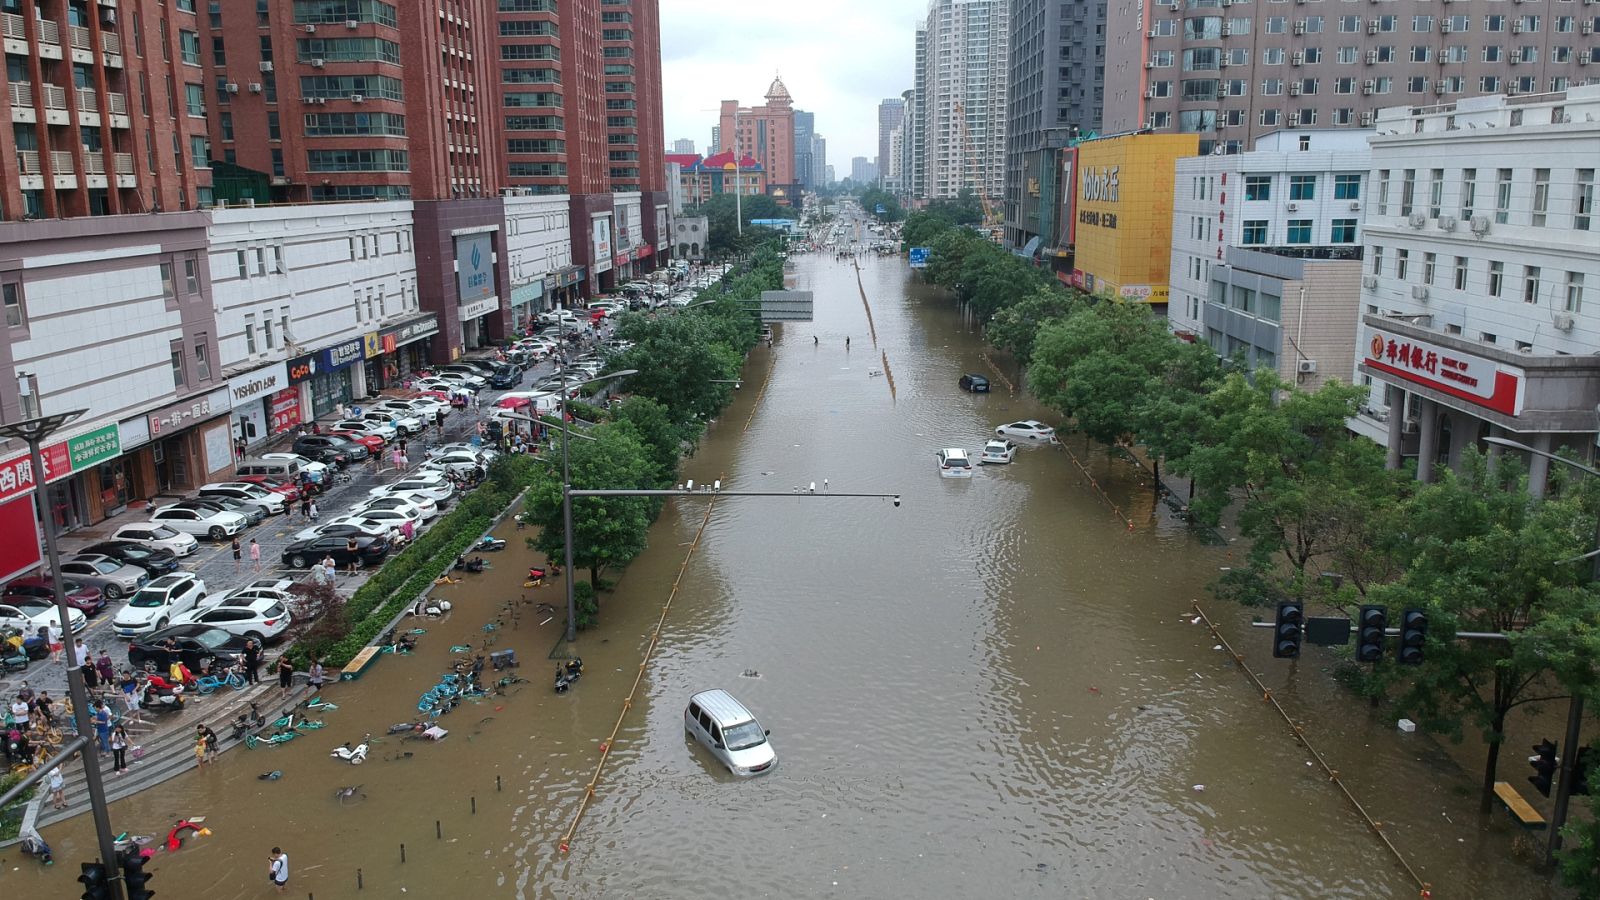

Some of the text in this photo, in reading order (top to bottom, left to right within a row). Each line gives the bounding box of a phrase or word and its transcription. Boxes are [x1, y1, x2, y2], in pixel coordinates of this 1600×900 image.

[1082, 166, 1101, 201] Yolo
[1101, 165, 1119, 202] 永乐
[291, 365, 309, 379] CoCo
[1386, 339, 1438, 375] 郑州银行
